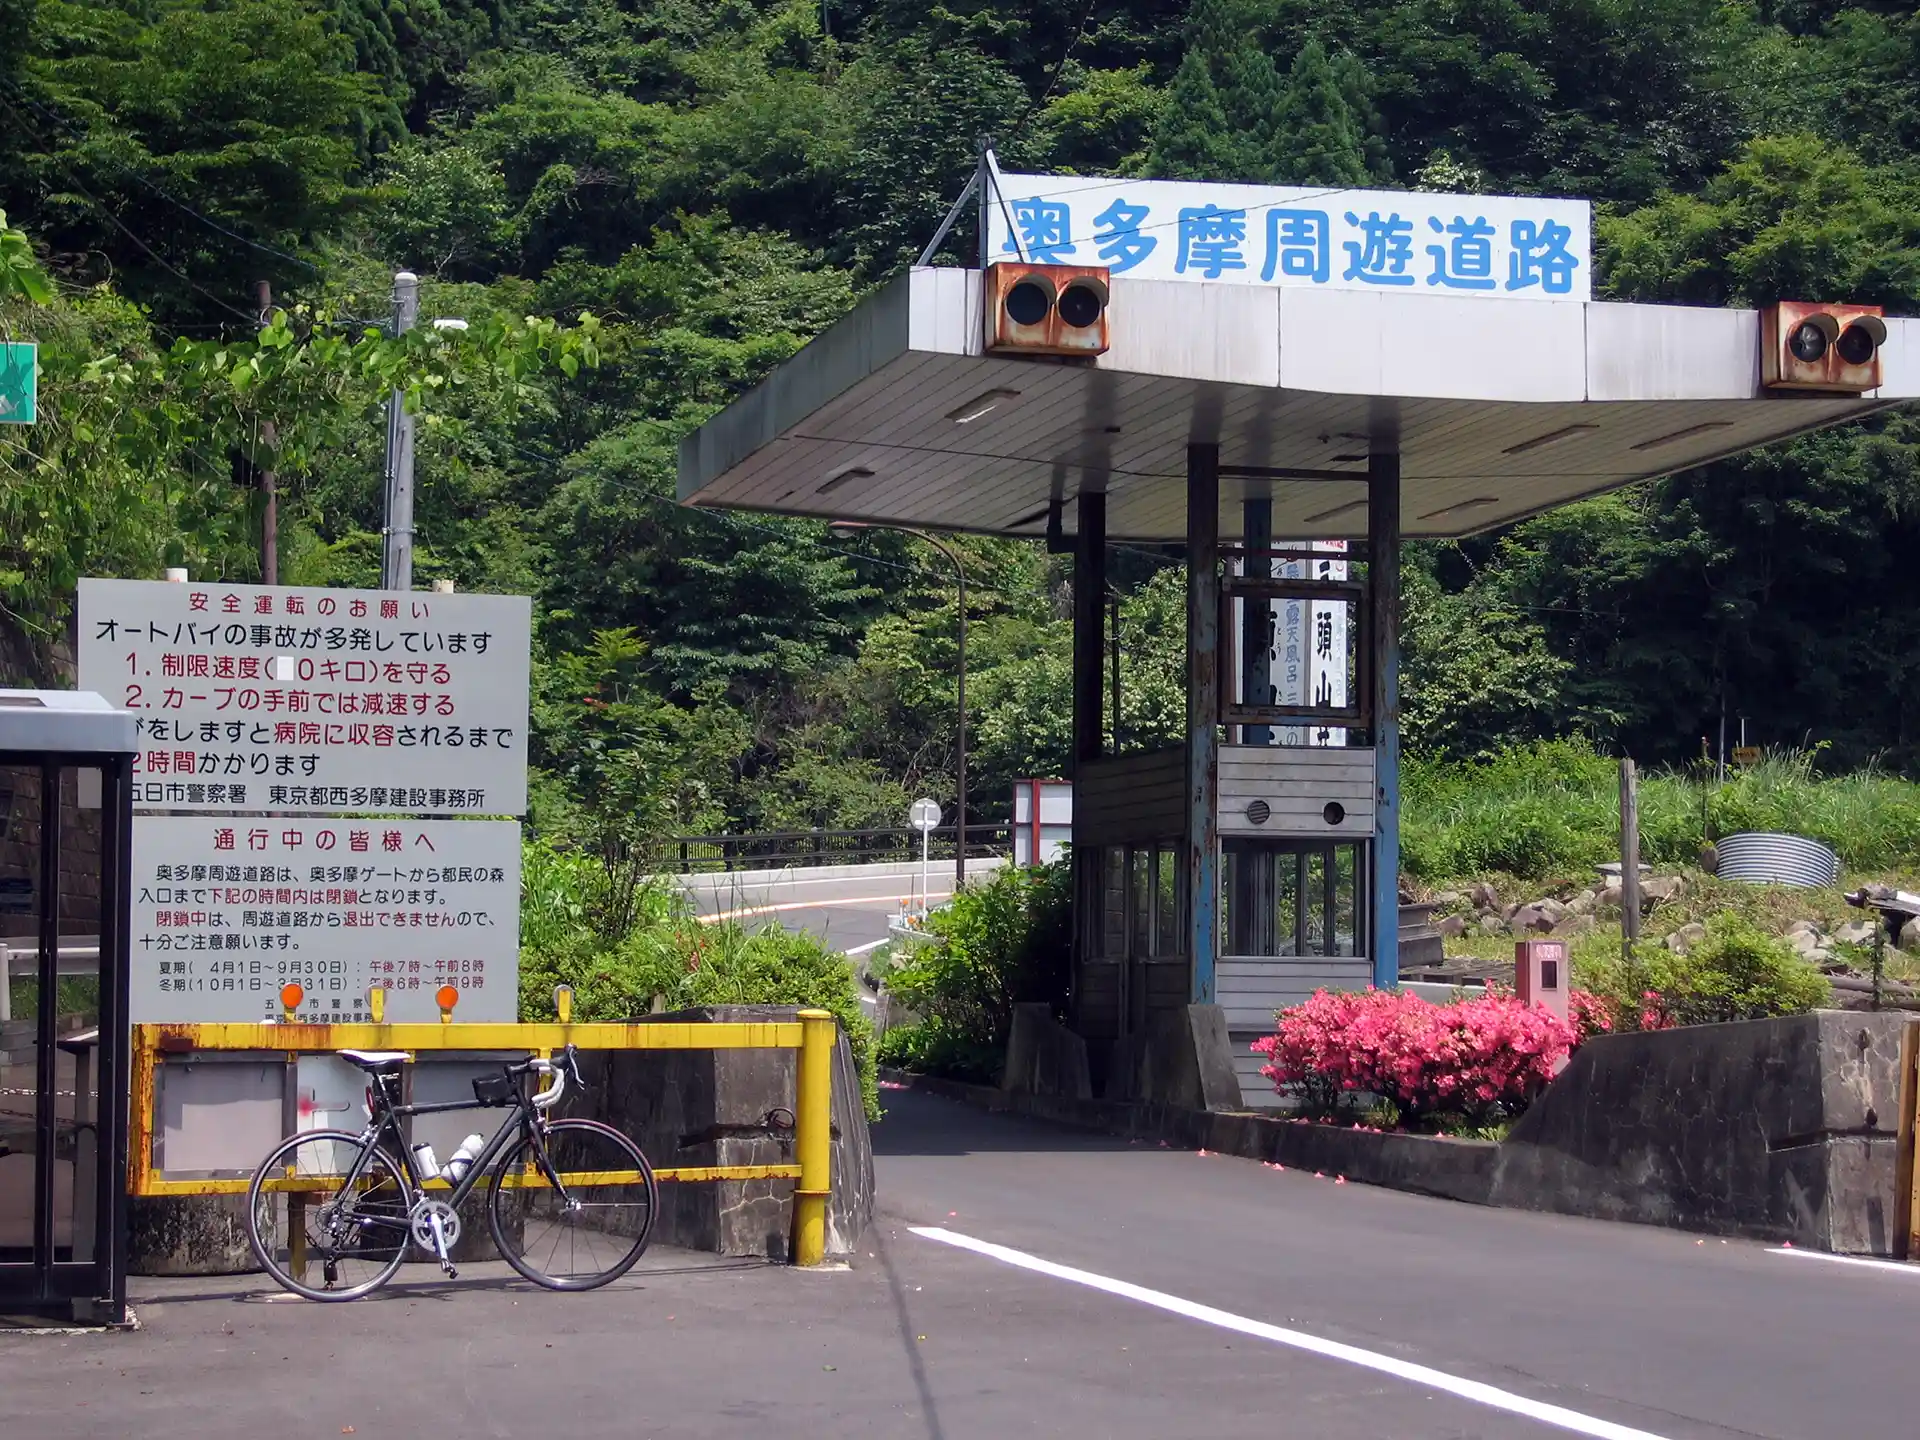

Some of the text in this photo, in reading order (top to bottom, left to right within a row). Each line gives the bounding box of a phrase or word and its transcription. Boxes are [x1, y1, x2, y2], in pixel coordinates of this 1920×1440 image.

[1002, 196, 1579, 294] 奥多摩周遊道路
[189, 592, 430, 619] 安全運転のお願い
[96, 620, 493, 653] オートバイの事故が多発しています
[126, 652, 452, 685] 1.制限速度(0キロ)を守る
[132, 782, 486, 808] 五日市警察署 東京都西多摩建設事務所
[213, 828, 436, 852] 通行中の皆様へ
[156, 864, 505, 883] 奥多摩周遊道路は、奥多摩ゲートから都民の森
[138, 887, 448, 905] 入口まで下記の時間内は閉鎖となります。
[156, 910, 495, 928] 閉鎖中は、周遊道路から退出できませんので、
[138, 933, 301, 950] 十分ご注意願います。
